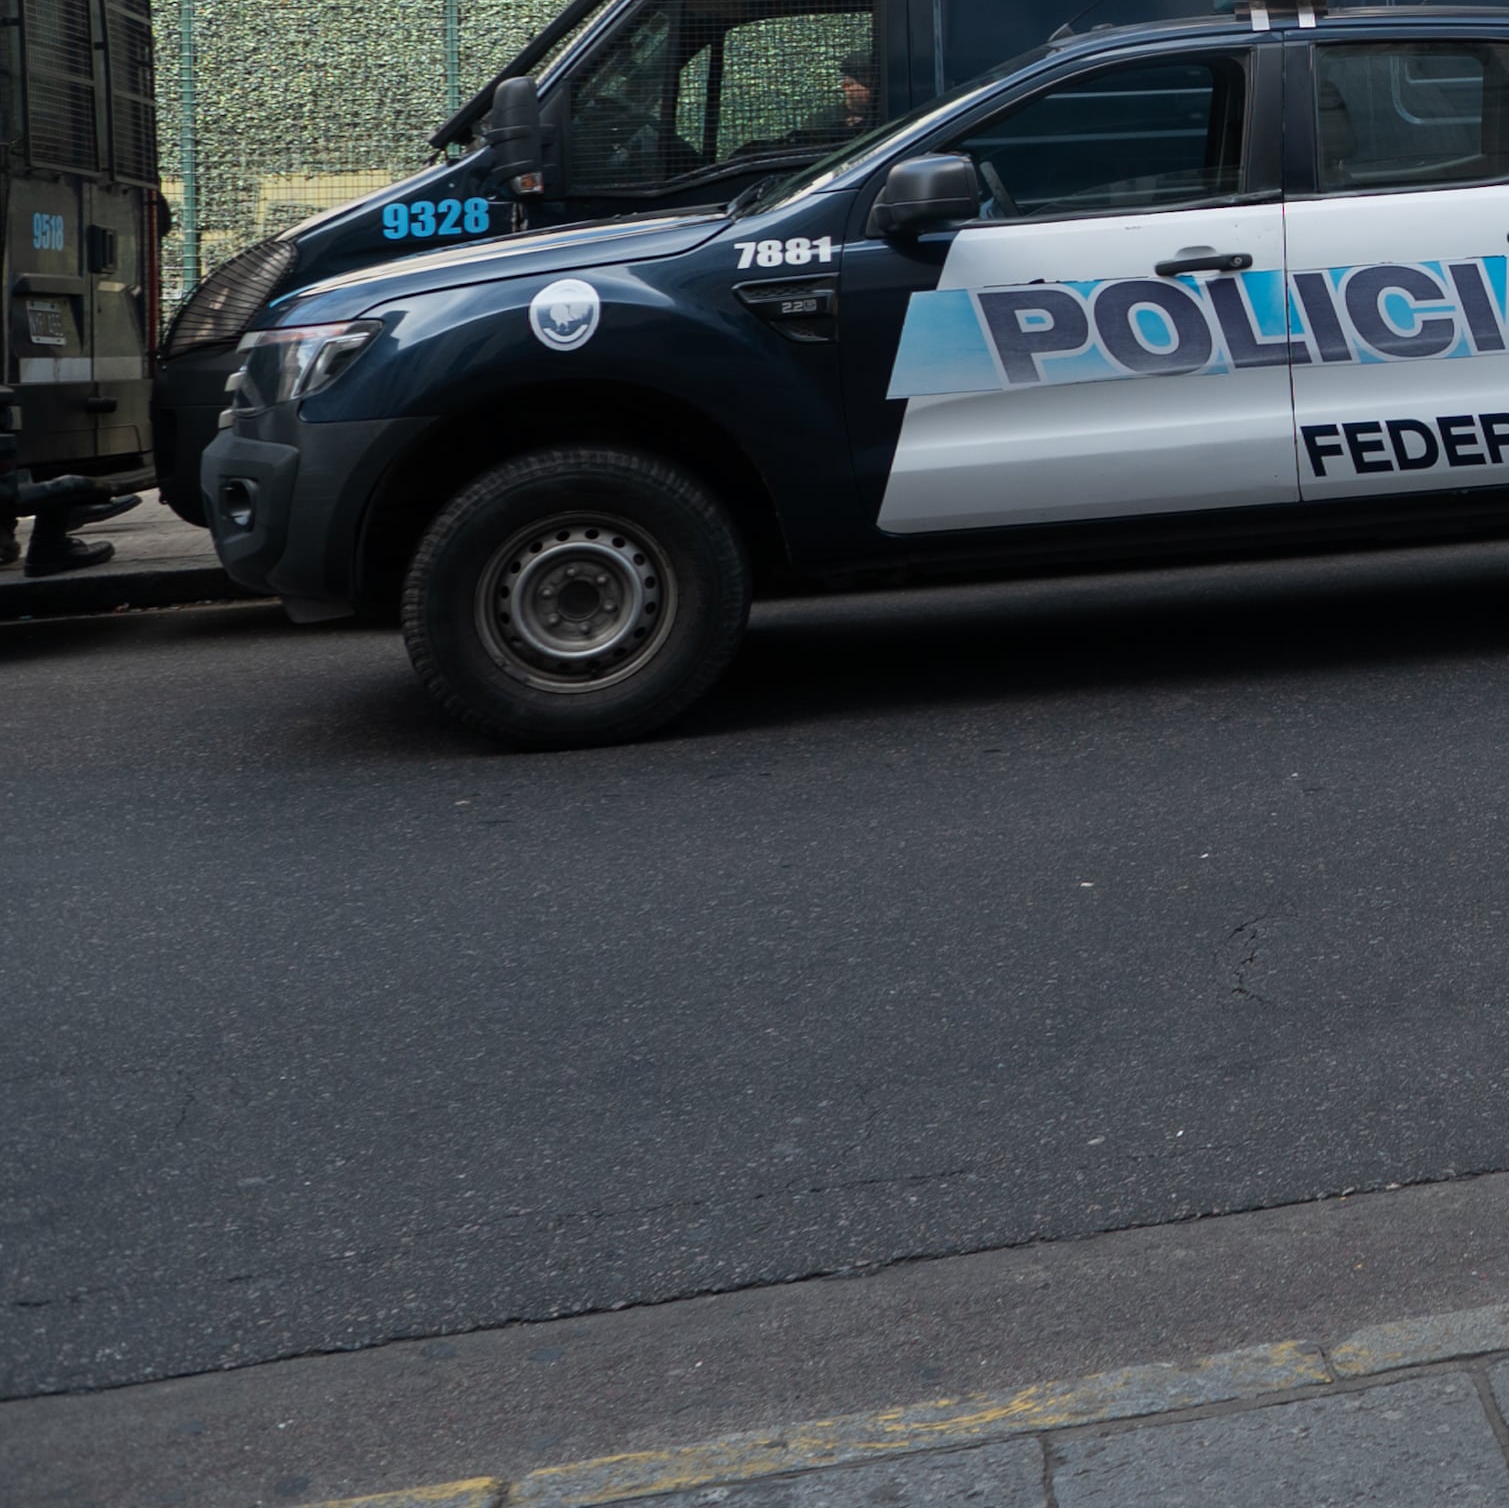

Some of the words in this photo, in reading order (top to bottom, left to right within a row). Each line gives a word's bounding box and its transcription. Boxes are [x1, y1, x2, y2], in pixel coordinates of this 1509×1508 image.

[33, 212, 64, 251] 9518
[383, 197, 489, 240] 9328
[733, 236, 832, 270] 7881
